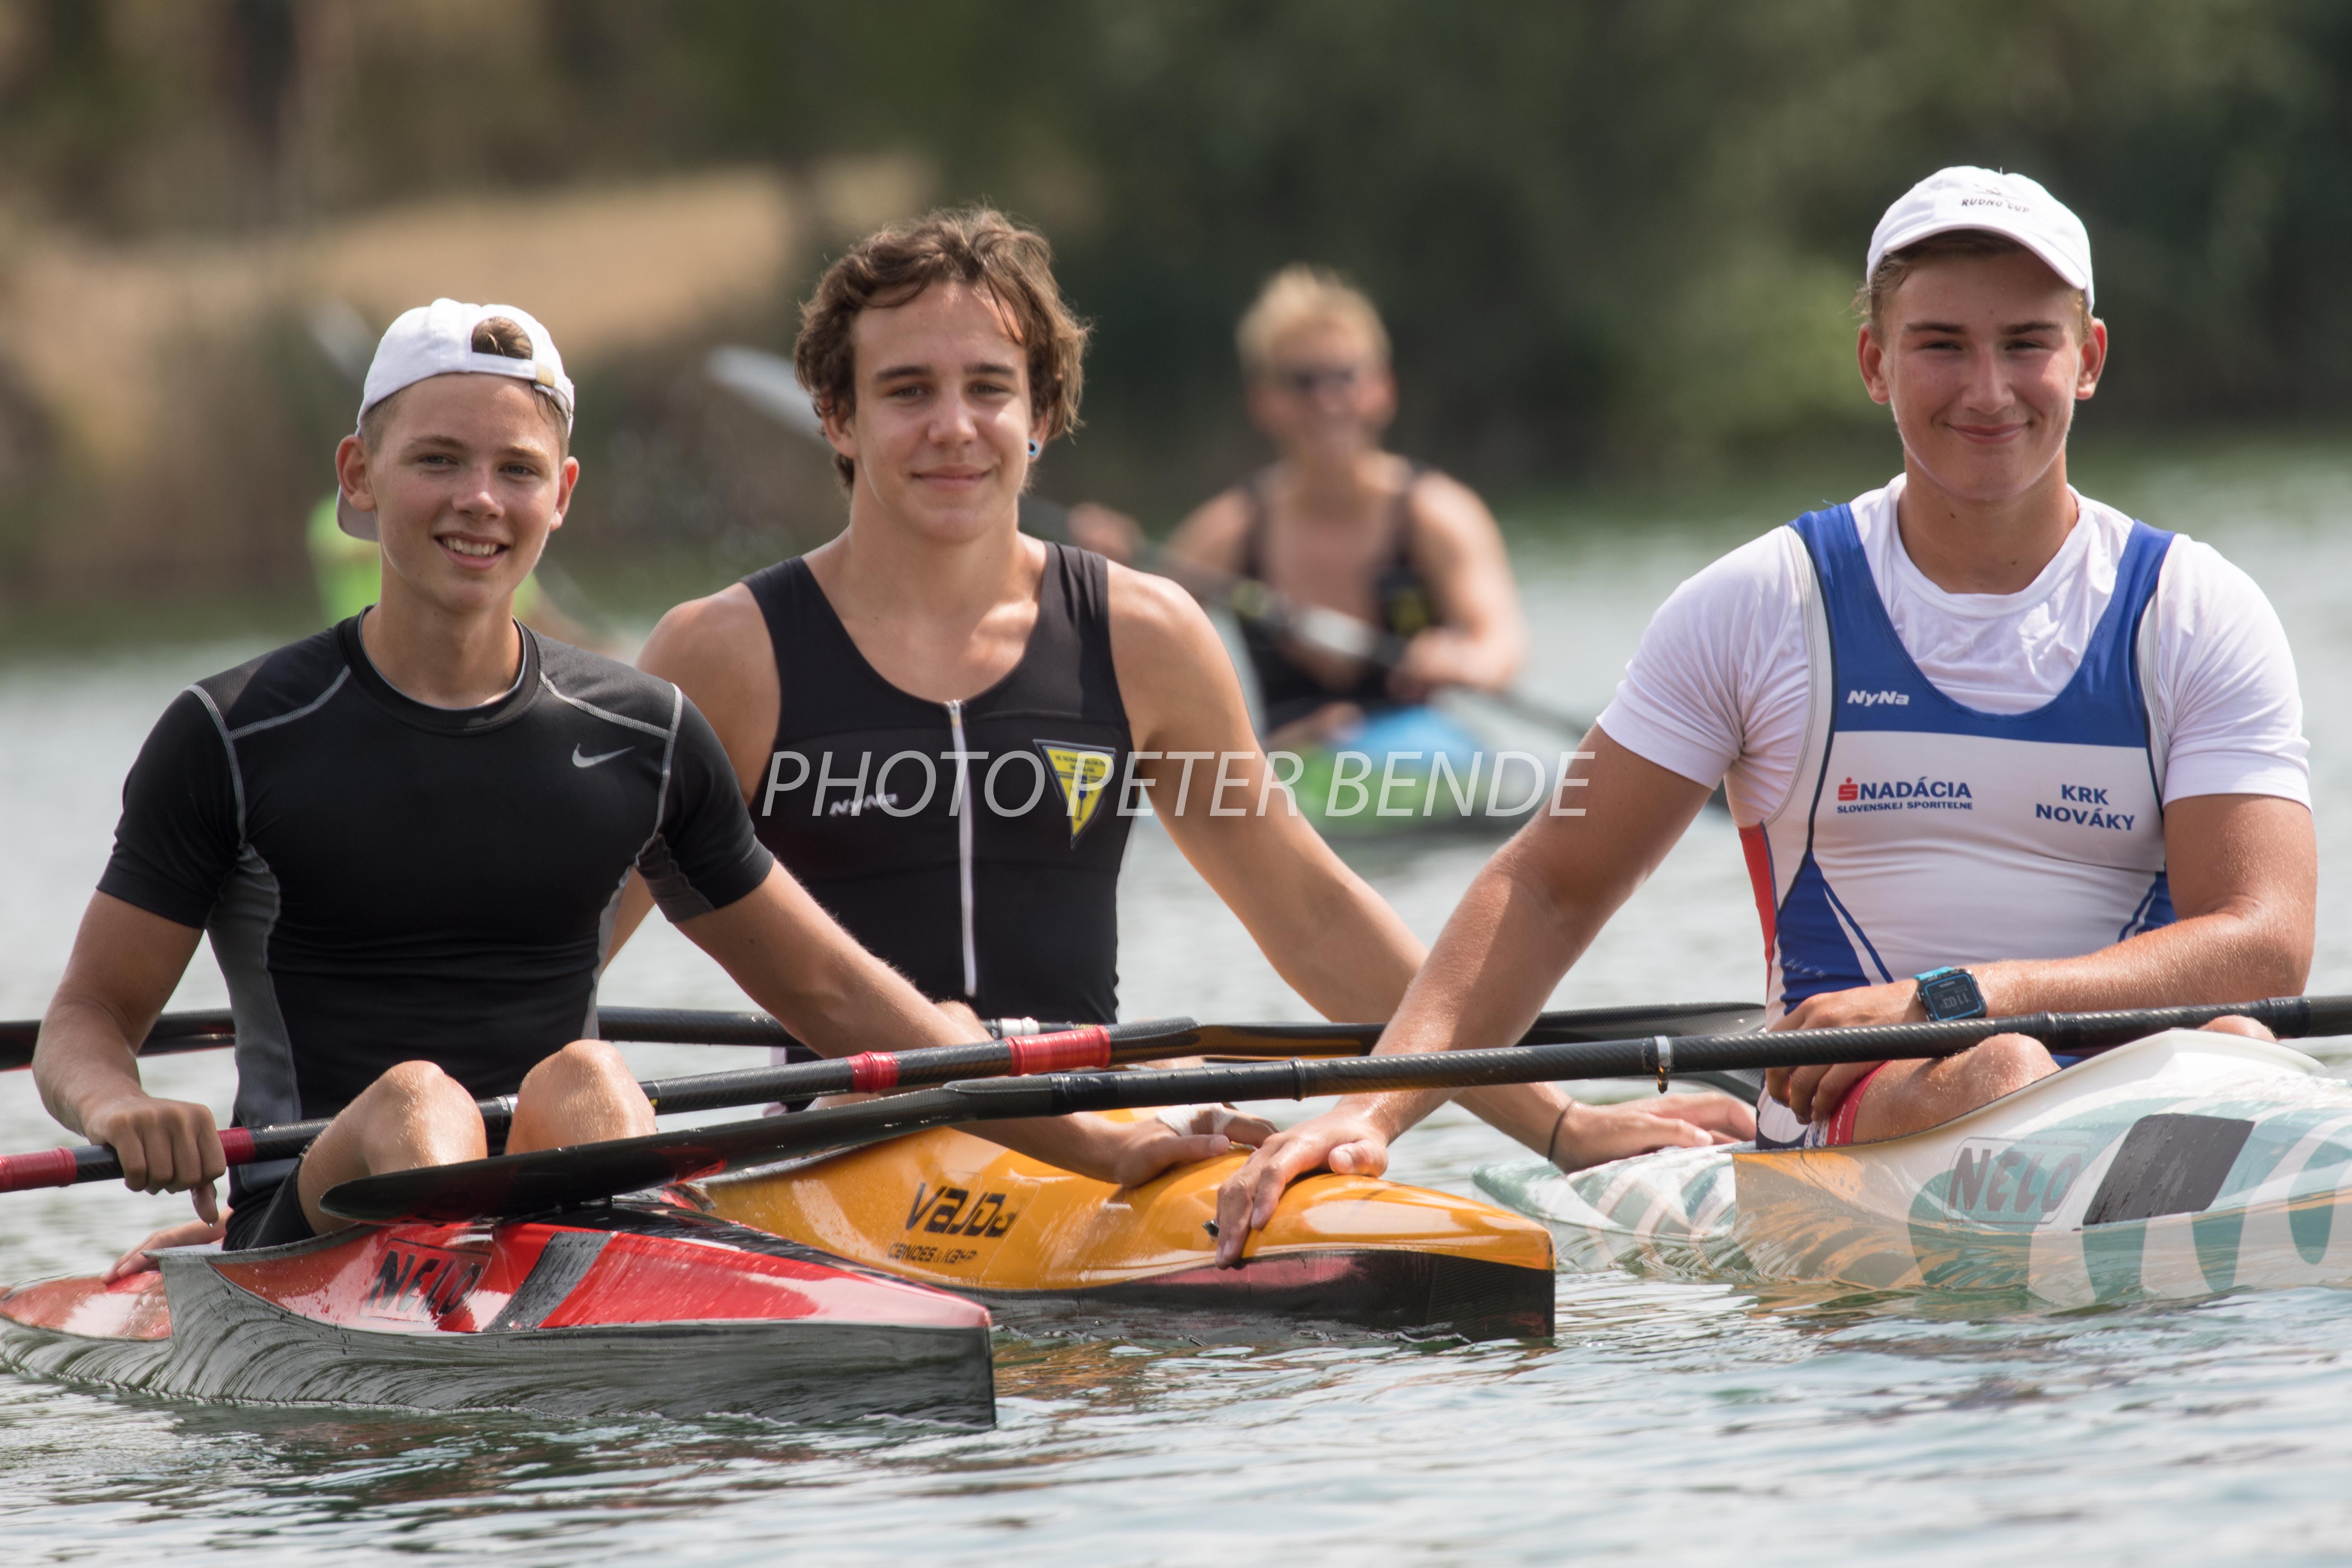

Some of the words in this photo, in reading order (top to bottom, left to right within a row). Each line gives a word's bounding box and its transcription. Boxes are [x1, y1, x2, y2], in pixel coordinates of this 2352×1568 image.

[2007, 203, 2030, 213] CUP
[1847, 690, 1909, 707] NyNa
[1860, 777, 1972, 800] NADÁCIA
[2061, 784, 2109, 805] KRK
[1837, 802, 1903, 813] SLOVENSKEJ
[2035, 804, 2135, 830] NOVÁKY
[1947, 1147, 2081, 1213] NELO
[365, 1250, 482, 1315] NELO
